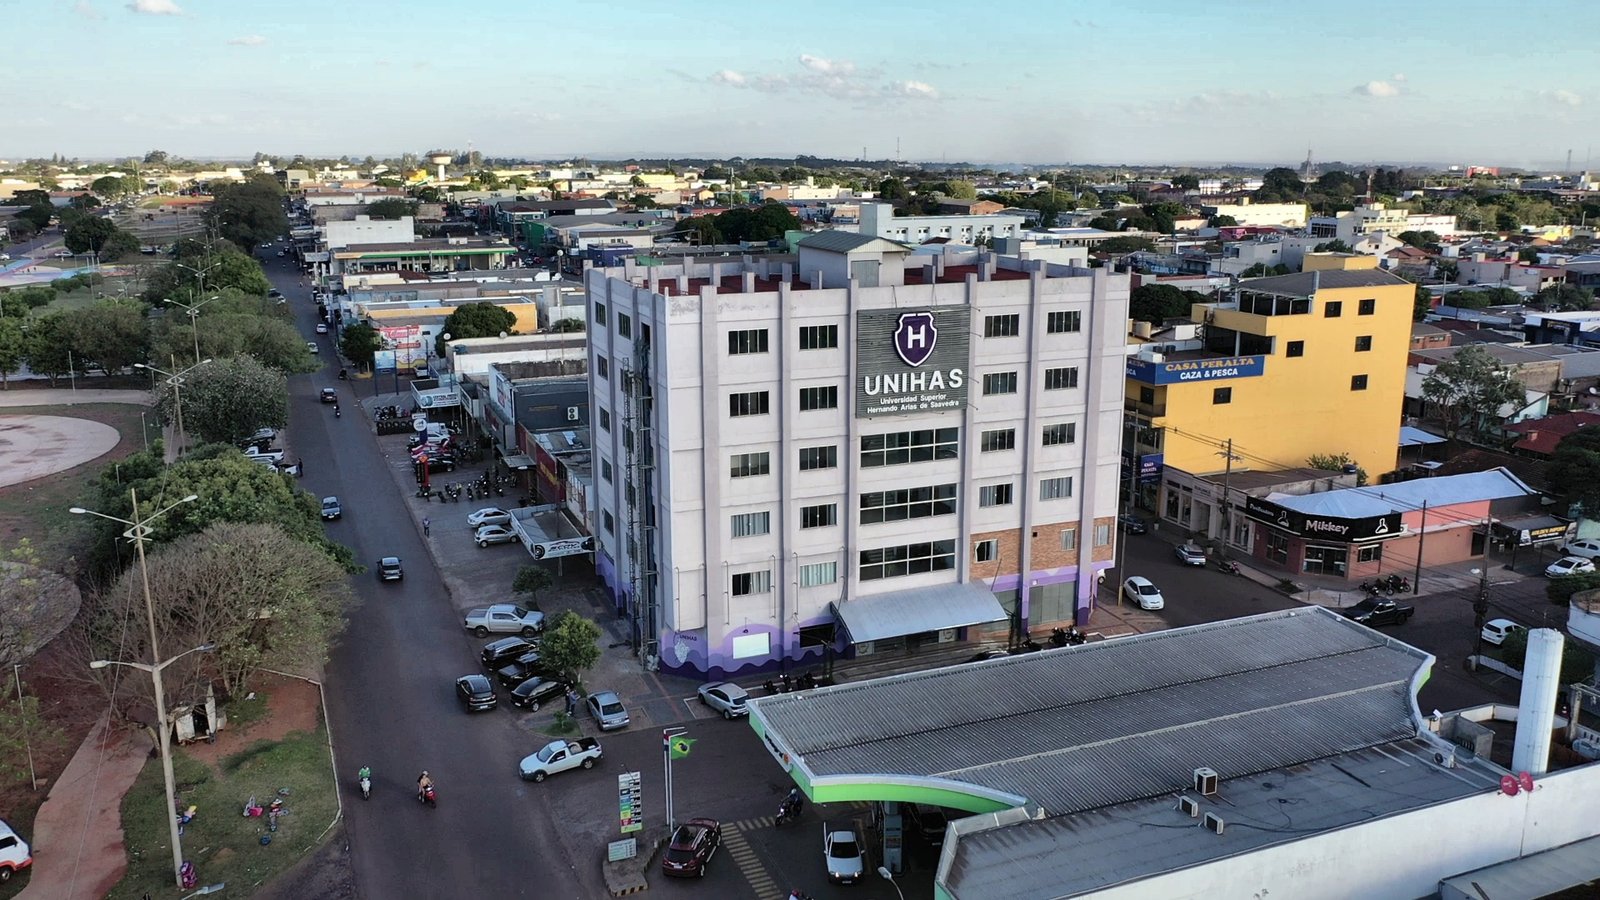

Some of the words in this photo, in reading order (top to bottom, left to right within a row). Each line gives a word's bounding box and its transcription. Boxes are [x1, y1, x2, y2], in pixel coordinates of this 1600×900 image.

[907, 324, 926, 349] H
[1165, 362, 1198, 372] CASA
[1200, 358, 1255, 369] PERALTA
[1180, 371, 1202, 380] CAZA
[1204, 370, 1211, 378] &
[1211, 368, 1238, 377] PESCA
[864, 368, 963, 396] UNIHAS
[880, 395, 918, 405] Universidad
[920, 393, 947, 402] Superior
[867, 405, 898, 414] Hernando
[900, 403, 917, 411] Arias
[930, 400, 960, 408] Saavedra
[1305, 519, 1350, 535] Mikkey
